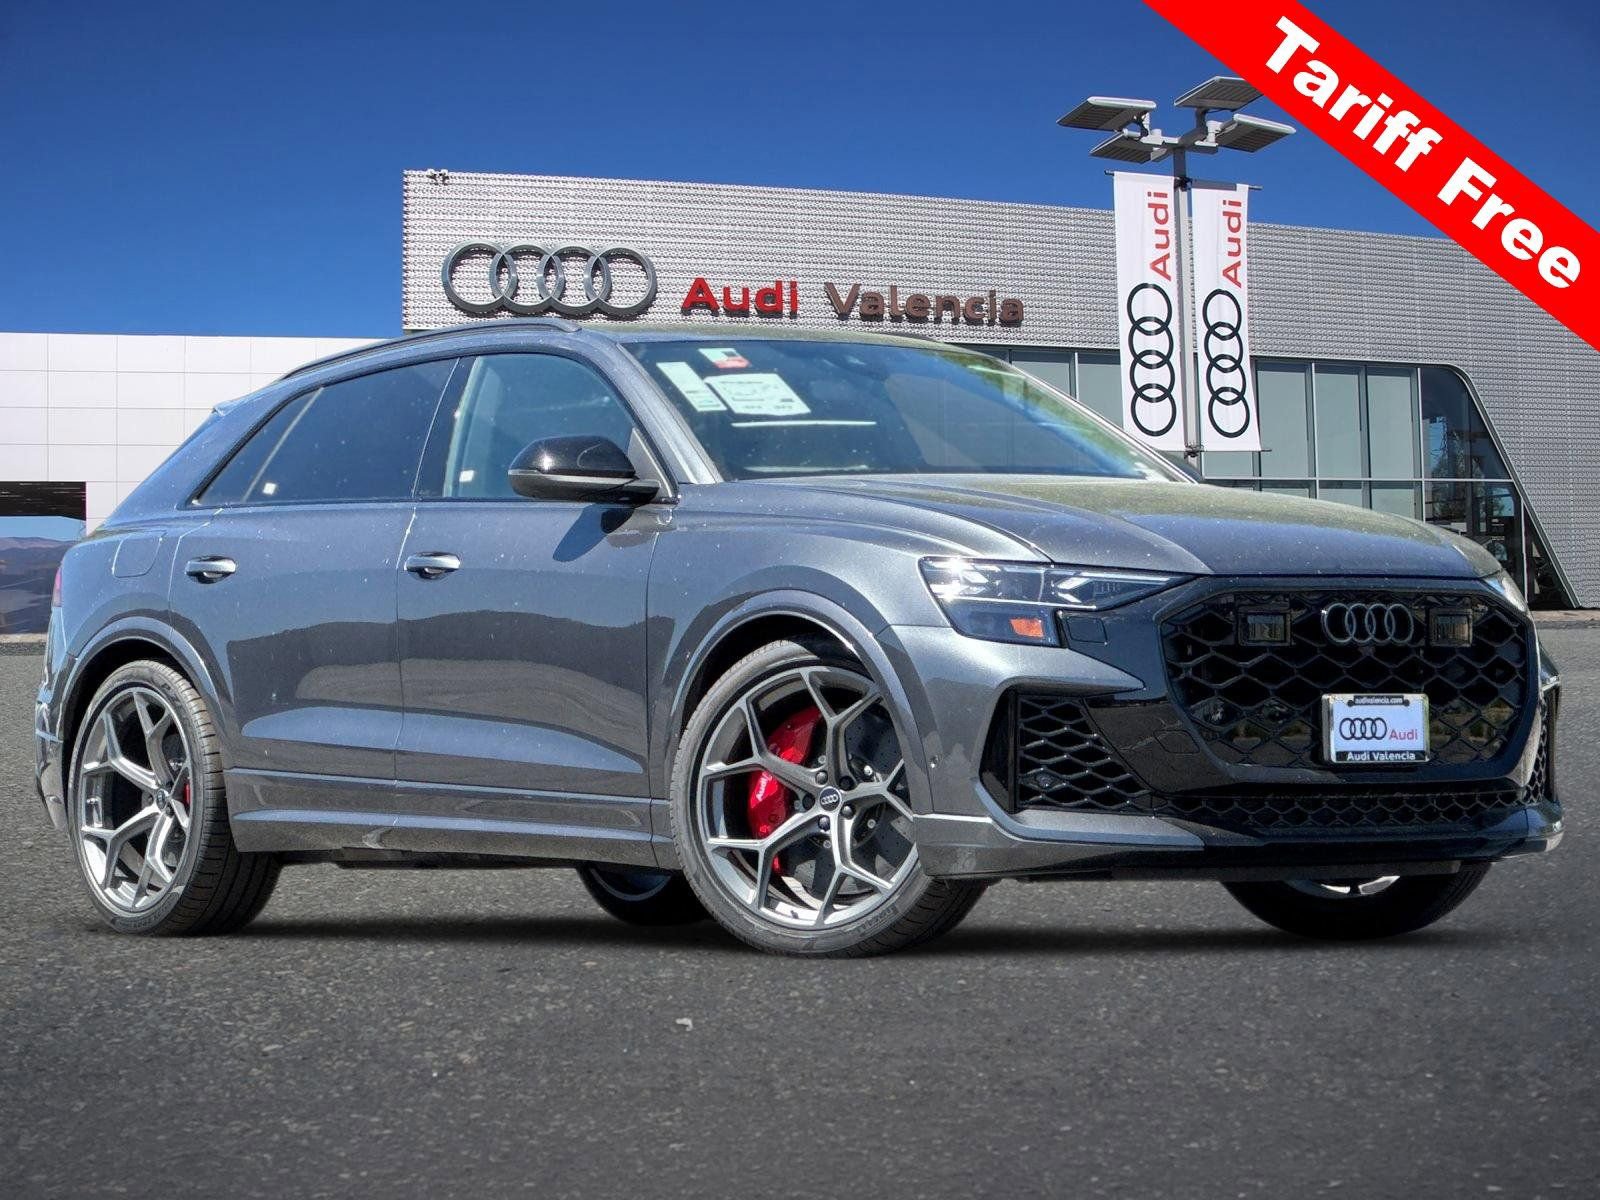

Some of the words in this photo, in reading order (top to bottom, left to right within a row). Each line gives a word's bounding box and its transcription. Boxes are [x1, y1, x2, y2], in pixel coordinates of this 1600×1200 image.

[1147, 191, 1172, 282] Audi
[1222, 199, 1242, 289] Audi
[681, 277, 799, 316] Audi
[824, 282, 1024, 327] Valencia
[1346, 752, 1370, 761] Audi
[1372, 752, 1416, 761] Valencia
[1388, 729, 1418, 740] Audi
